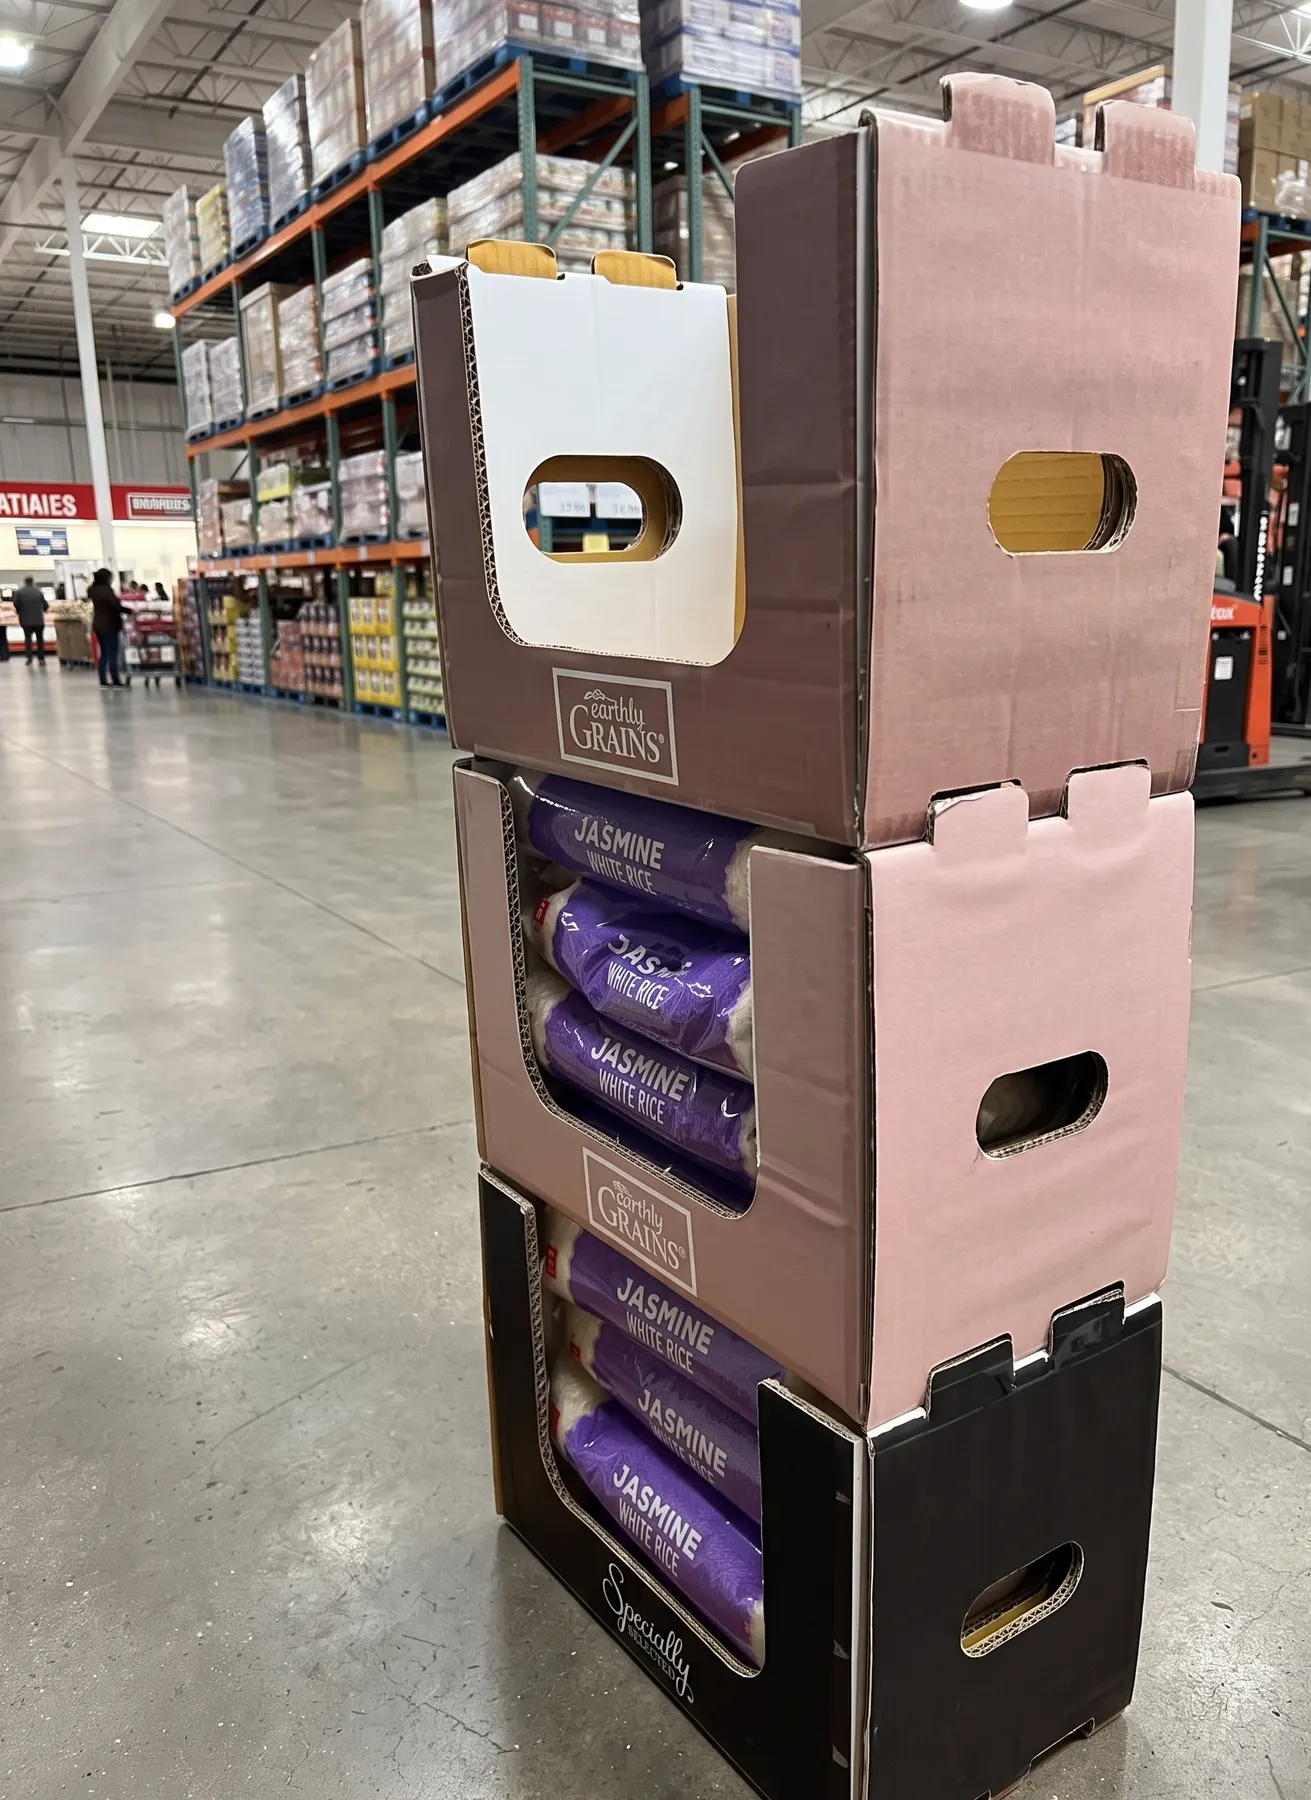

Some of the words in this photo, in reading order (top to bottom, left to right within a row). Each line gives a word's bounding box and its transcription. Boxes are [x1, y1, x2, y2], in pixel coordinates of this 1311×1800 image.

[591, 696, 646, 732] earthly
[574, 816, 665, 870] JASMINE
[586, 849, 627, 884] WHITE
[625, 863, 657, 895] RICE
[607, 961, 642, 998] WHITE
[635, 979, 670, 1010] RICE
[591, 1037, 690, 1102] JASMINE
[599, 1068, 635, 1109] WHITE
[638, 1089, 666, 1125] RICE
[616, 1192, 663, 1235] earthly
[616, 1276, 716, 1355] JASMINE
[626, 1311, 662, 1353] WHITE
[666, 1338, 694, 1374] RICE
[637, 1388, 728, 1478] JASMINE
[613, 1464, 703, 1561] JASMINE
[618, 1497, 652, 1551] WHITE
[654, 1532, 679, 1578] RICE
[602, 1562, 695, 1704] Specially
